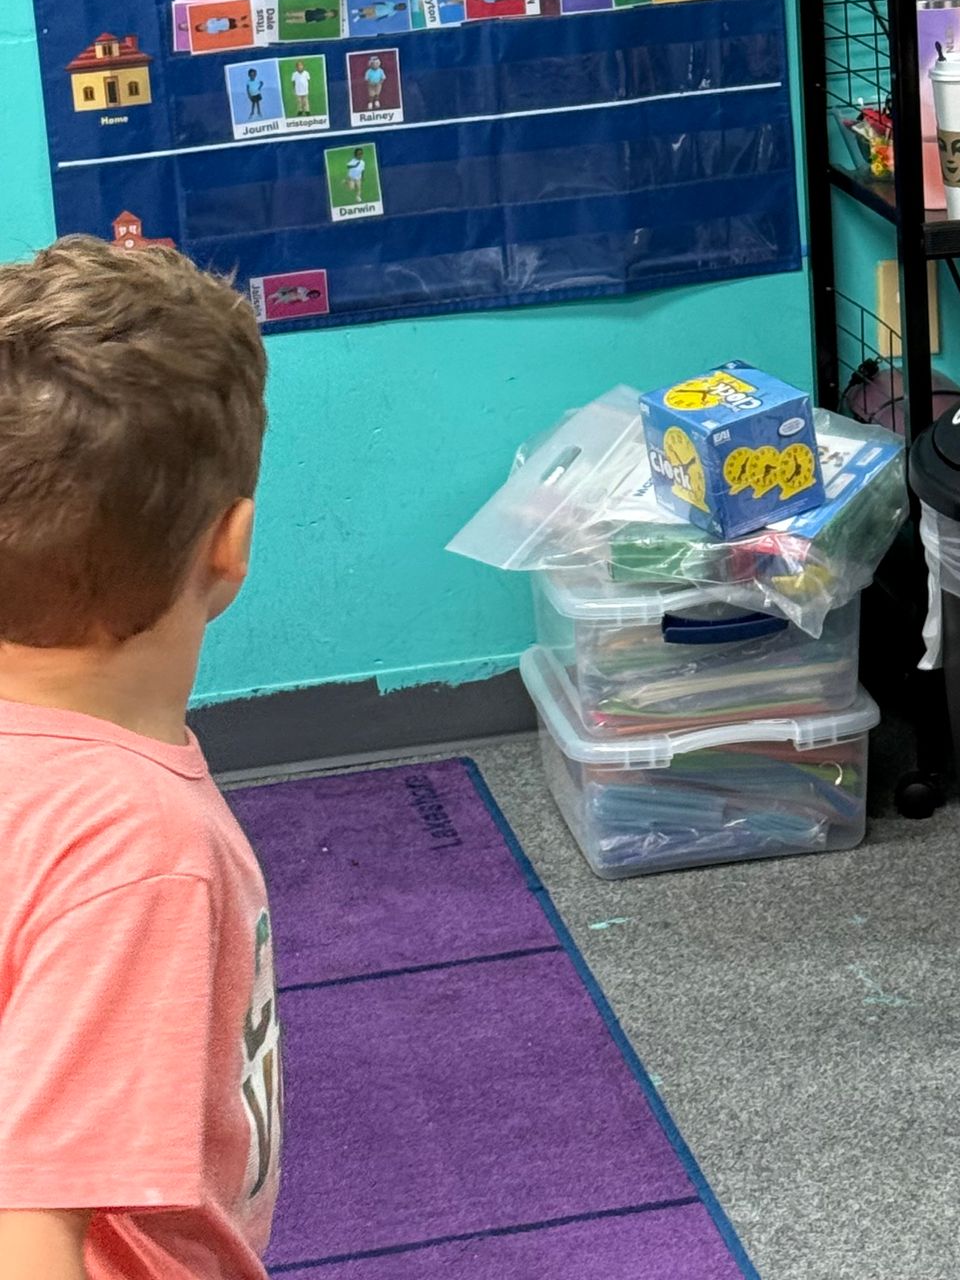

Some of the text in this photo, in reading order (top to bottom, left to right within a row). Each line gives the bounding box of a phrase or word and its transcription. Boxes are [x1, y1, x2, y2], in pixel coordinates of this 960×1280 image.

[266, 7, 276, 31] Dale
[100, 115, 129, 126] Home
[359, 110, 395, 123] Rainey
[339, 204, 376, 217] Darwin
[649, 450, 692, 491] Clock
